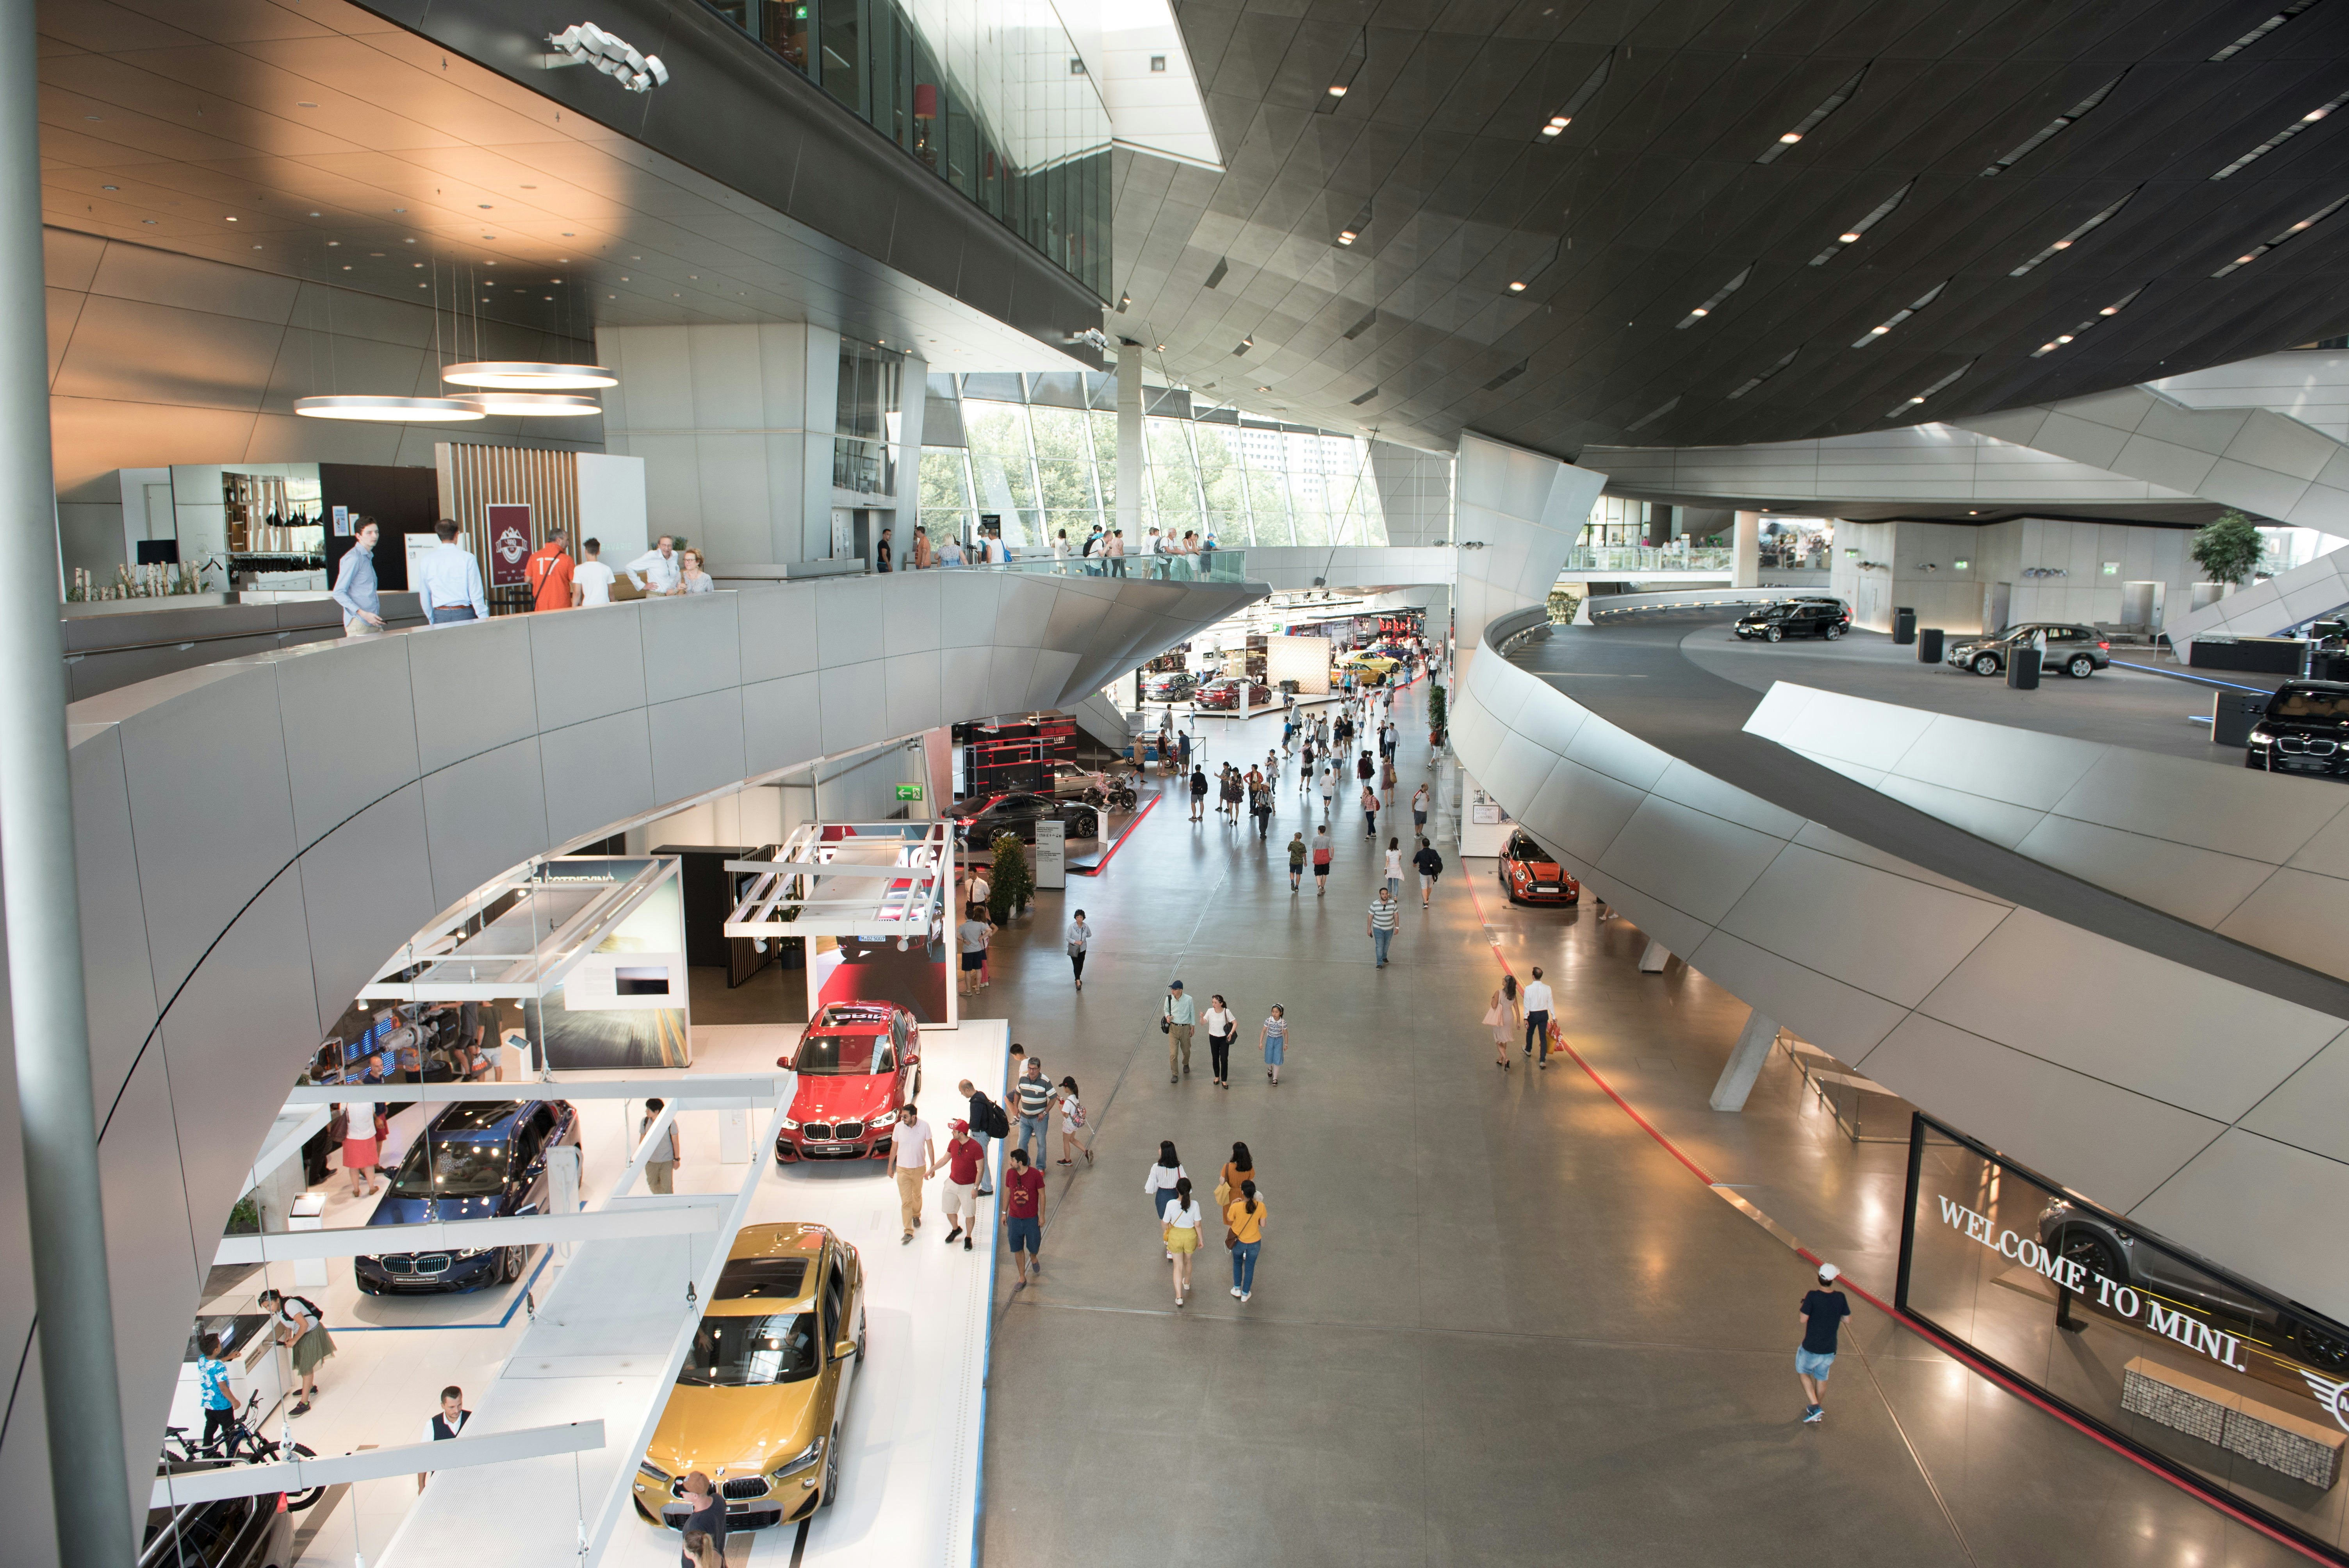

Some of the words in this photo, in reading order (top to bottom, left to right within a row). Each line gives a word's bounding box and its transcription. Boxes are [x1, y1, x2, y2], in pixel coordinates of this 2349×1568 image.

[536, 557, 560, 575] 17
[1938, 1195, 2087, 1294] WELCOME
[2094, 1274, 2139, 1317] TO
[2147, 1300, 2246, 1372] MINI.
